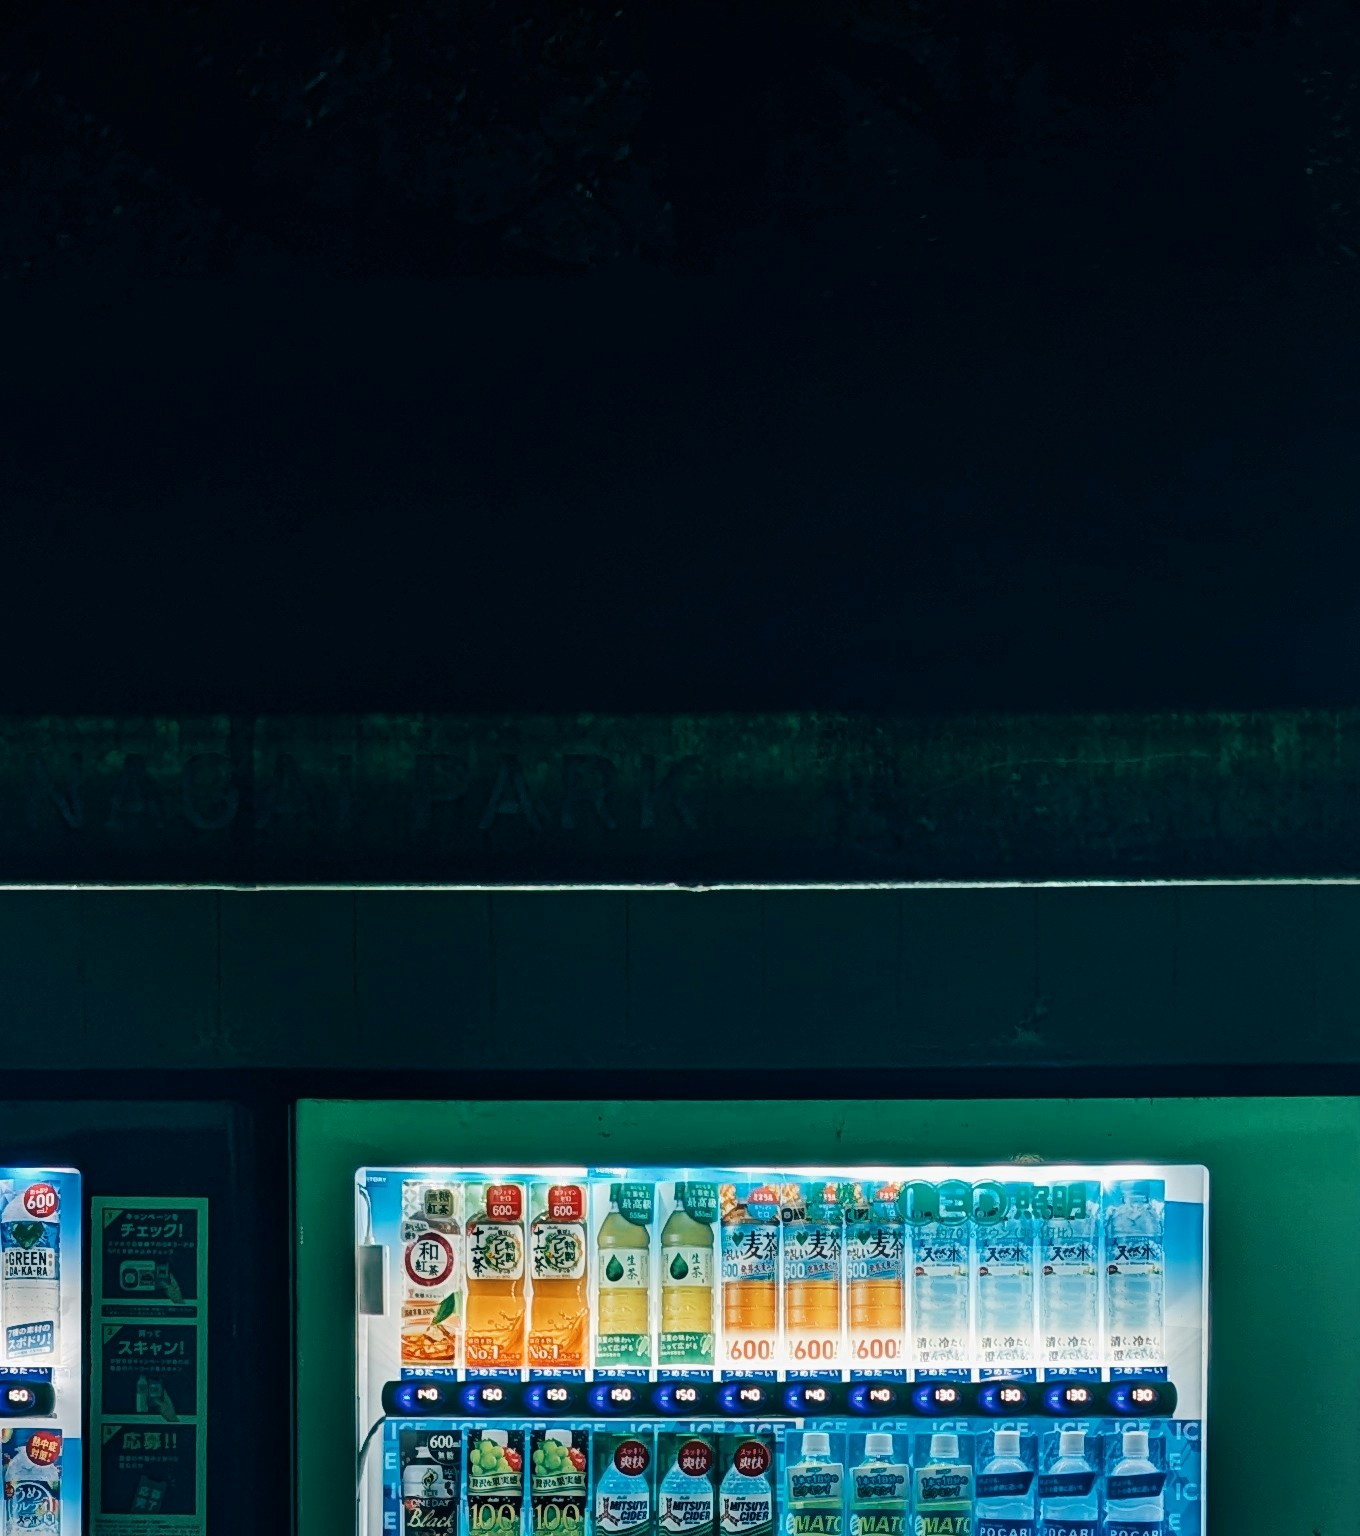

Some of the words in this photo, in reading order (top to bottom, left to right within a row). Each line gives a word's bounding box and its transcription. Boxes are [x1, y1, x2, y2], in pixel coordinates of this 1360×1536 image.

[418, 750, 700, 832] PARK
[120, 1223, 183, 1238] チェック!
[9, 1252, 47, 1265] GREEN
[418, 1242, 439, 1261] 和
[471, 1226, 487, 1277] 十六茶
[533, 1226, 545, 1277] 十六茶
[415, 1261, 439, 1276] 紅茶
[626, 1253, 638, 1279] 生茶
[118, 1341, 184, 1355] スキャン!
[469, 1345, 499, 1359] No.1
[529, 1345, 559, 1359] No.1
[122, 1431, 177, 1450] 応募!!
[620, 1455, 644, 1469] 爽快
[683, 1455, 707, 1469] 爽快
[610, 1501, 648, 1511] MITSUYA
[673, 1501, 710, 1511] MITSUYA
[407, 1508, 454, 1529] Black
[470, 1503, 515, 1530] 100
[535, 1503, 580, 1530] 100
[620, 1511, 647, 1521] CIDER
[683, 1511, 710, 1521] CIDER
